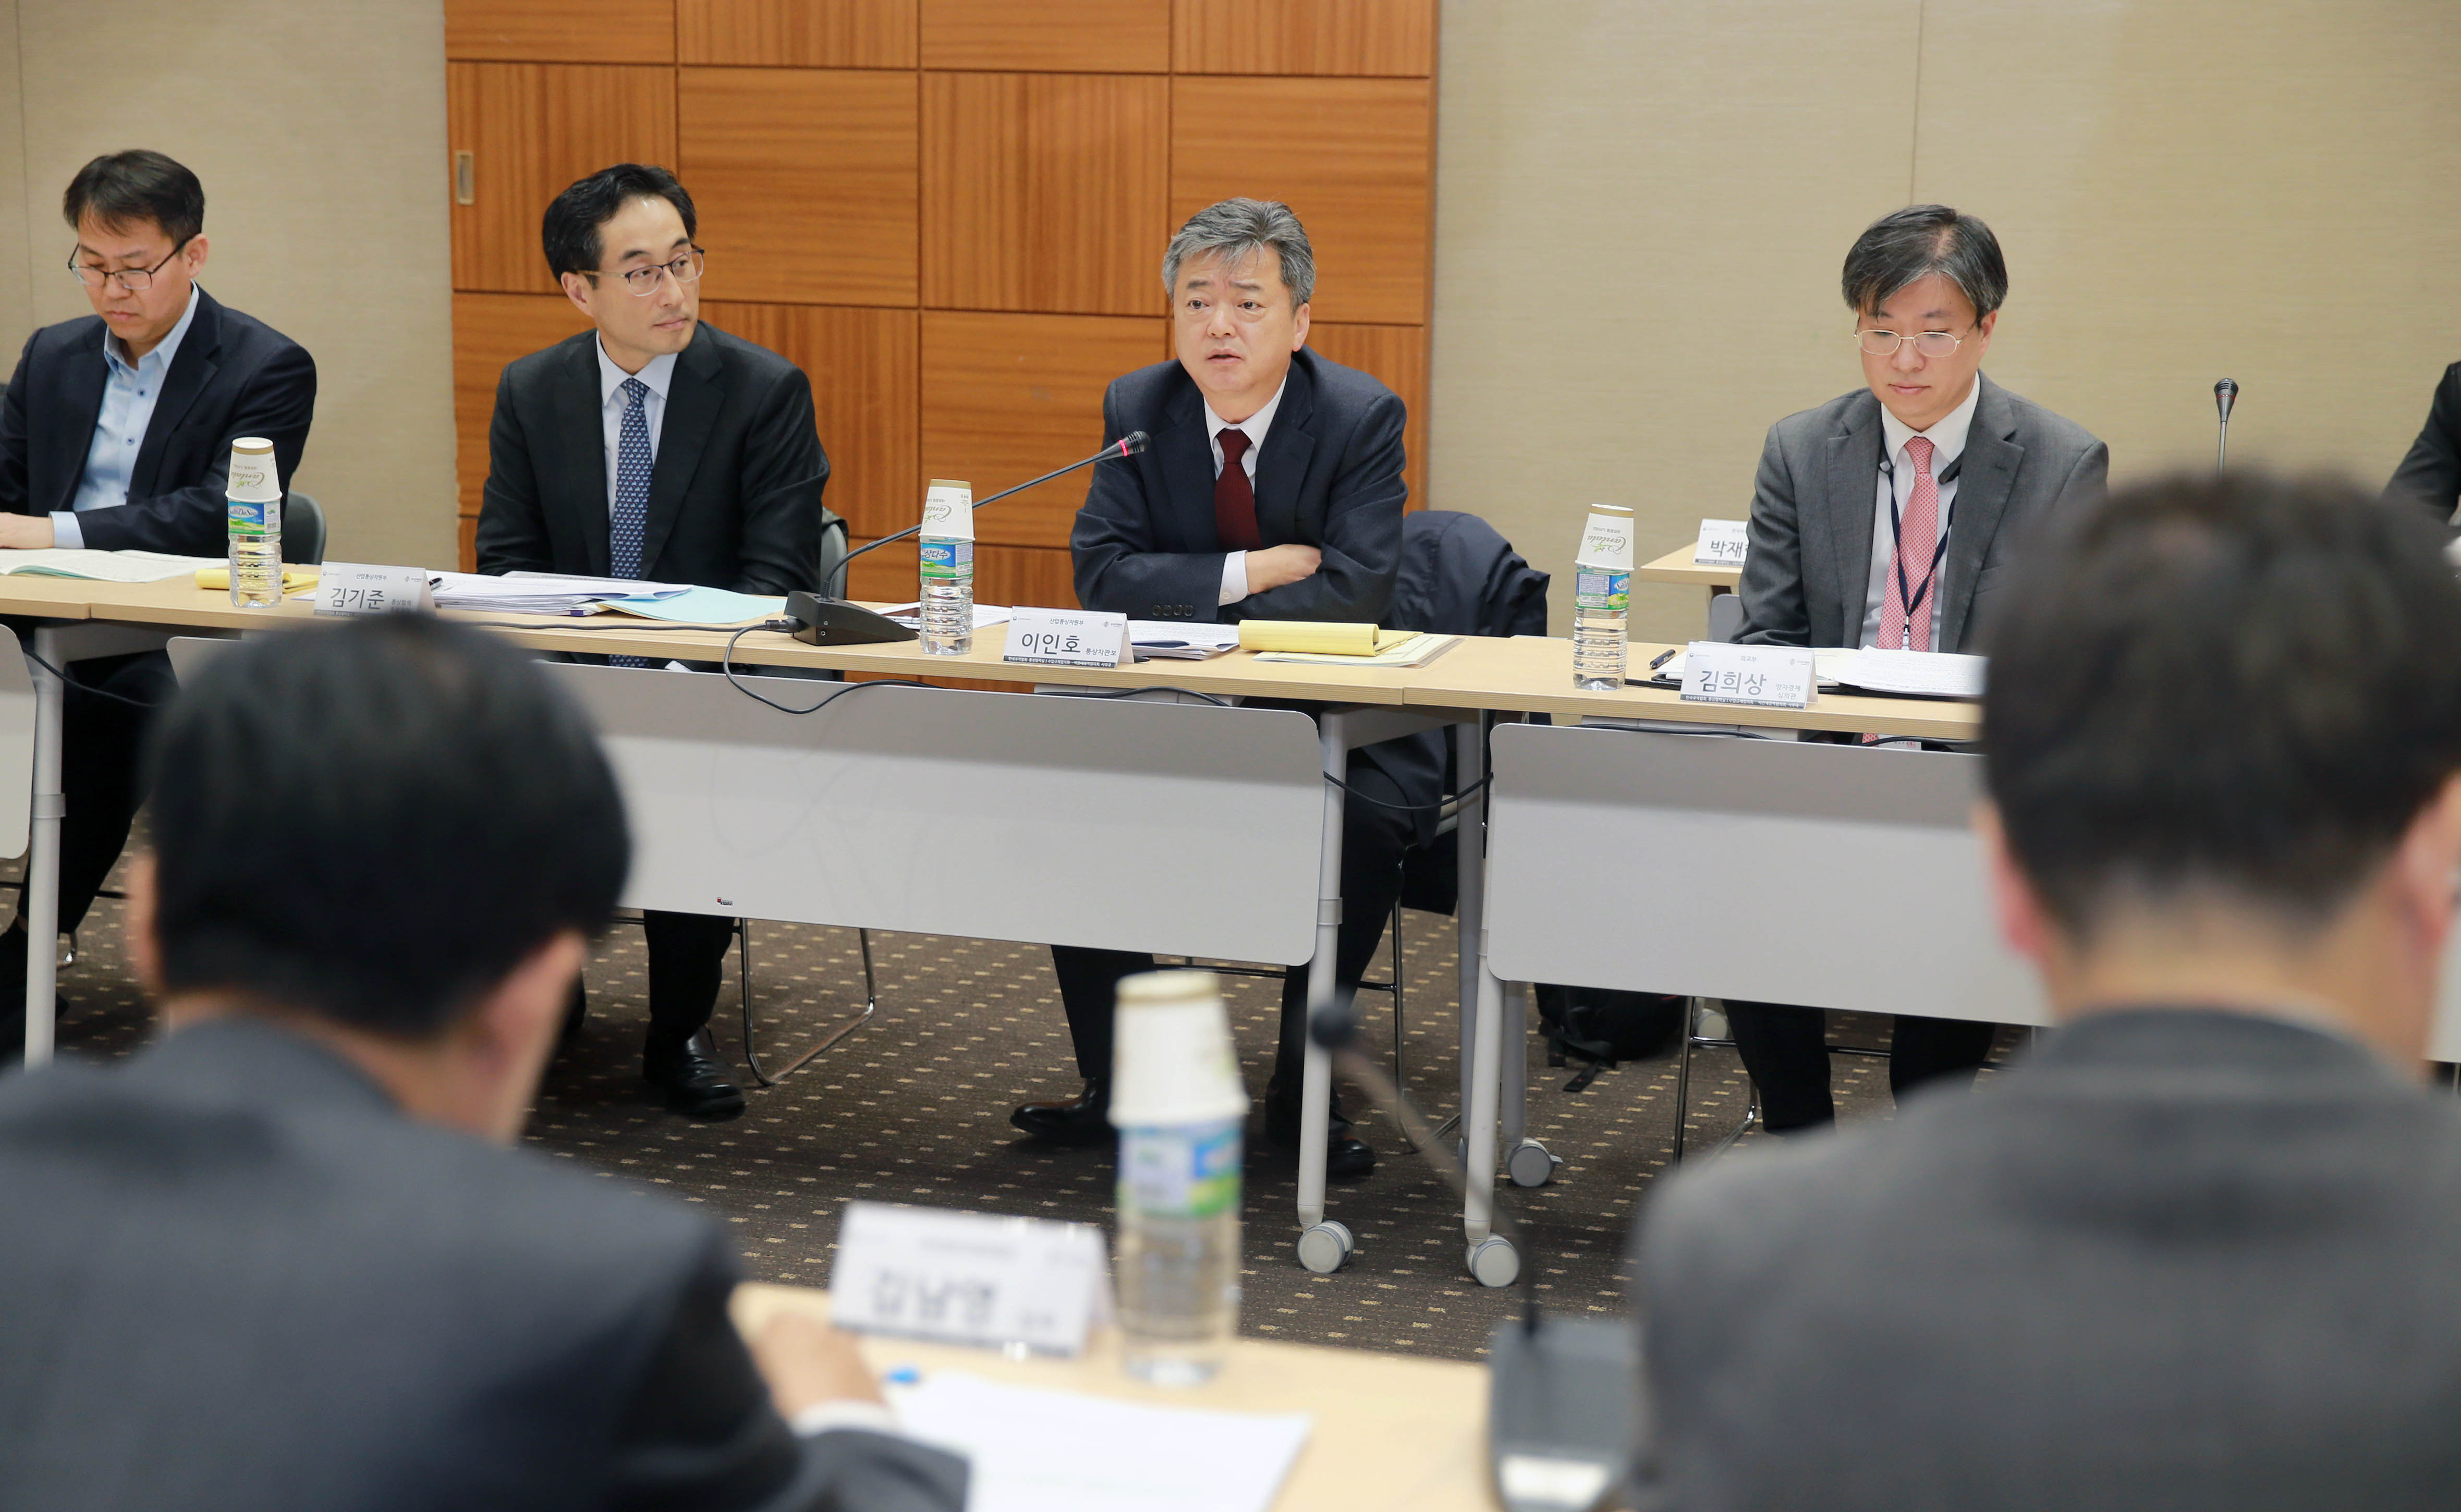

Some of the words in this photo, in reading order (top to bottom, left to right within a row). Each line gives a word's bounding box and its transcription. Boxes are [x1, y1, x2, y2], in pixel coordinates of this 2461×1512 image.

[922, 550, 947, 559] 삼다수
[330, 588, 384, 609] 김기준
[1021, 633, 1081, 655] 이인호
[1086, 648, 1117, 656] 통상차관보
[1700, 670, 1767, 696] 김희상
[1776, 683, 1800, 692] 양자경제
